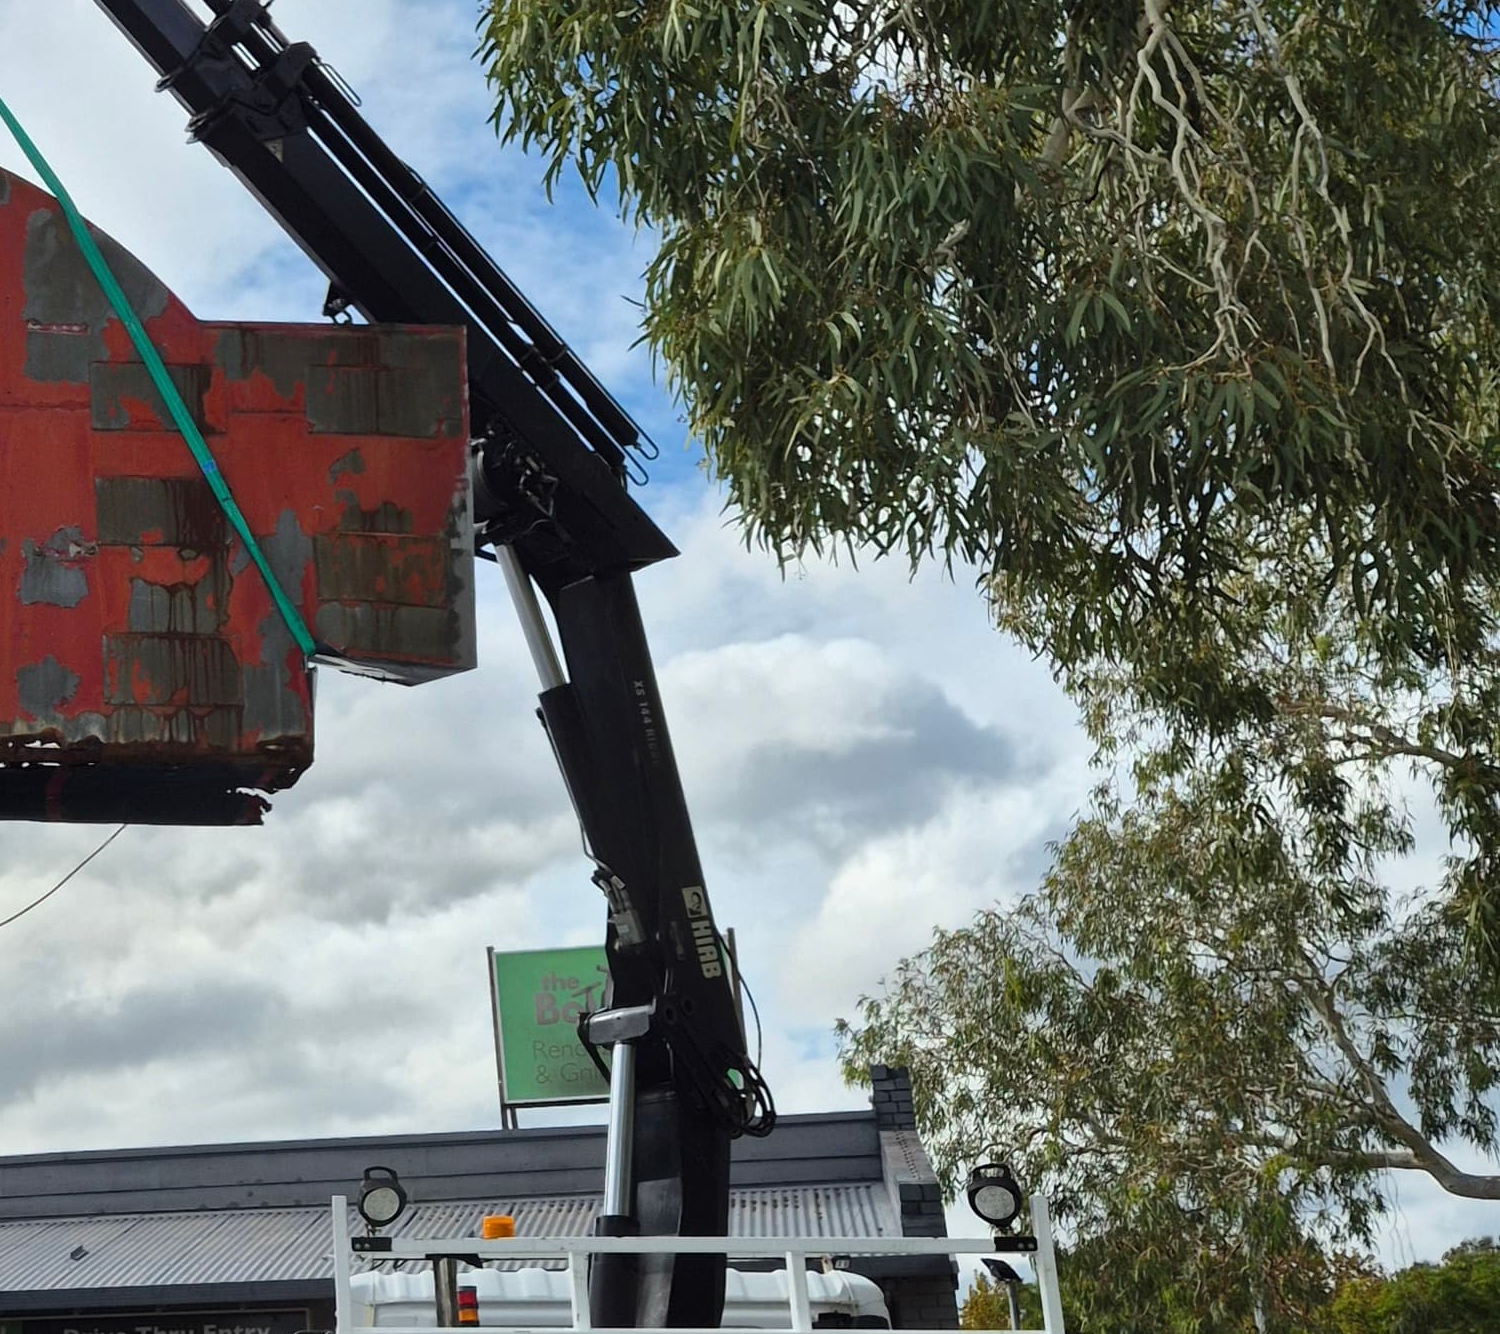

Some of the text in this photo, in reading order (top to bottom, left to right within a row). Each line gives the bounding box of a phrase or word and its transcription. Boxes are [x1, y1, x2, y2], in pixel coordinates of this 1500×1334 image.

[691, 920, 723, 979] HIAB
[541, 971, 579, 992] the
[536, 1065, 553, 1084] &
